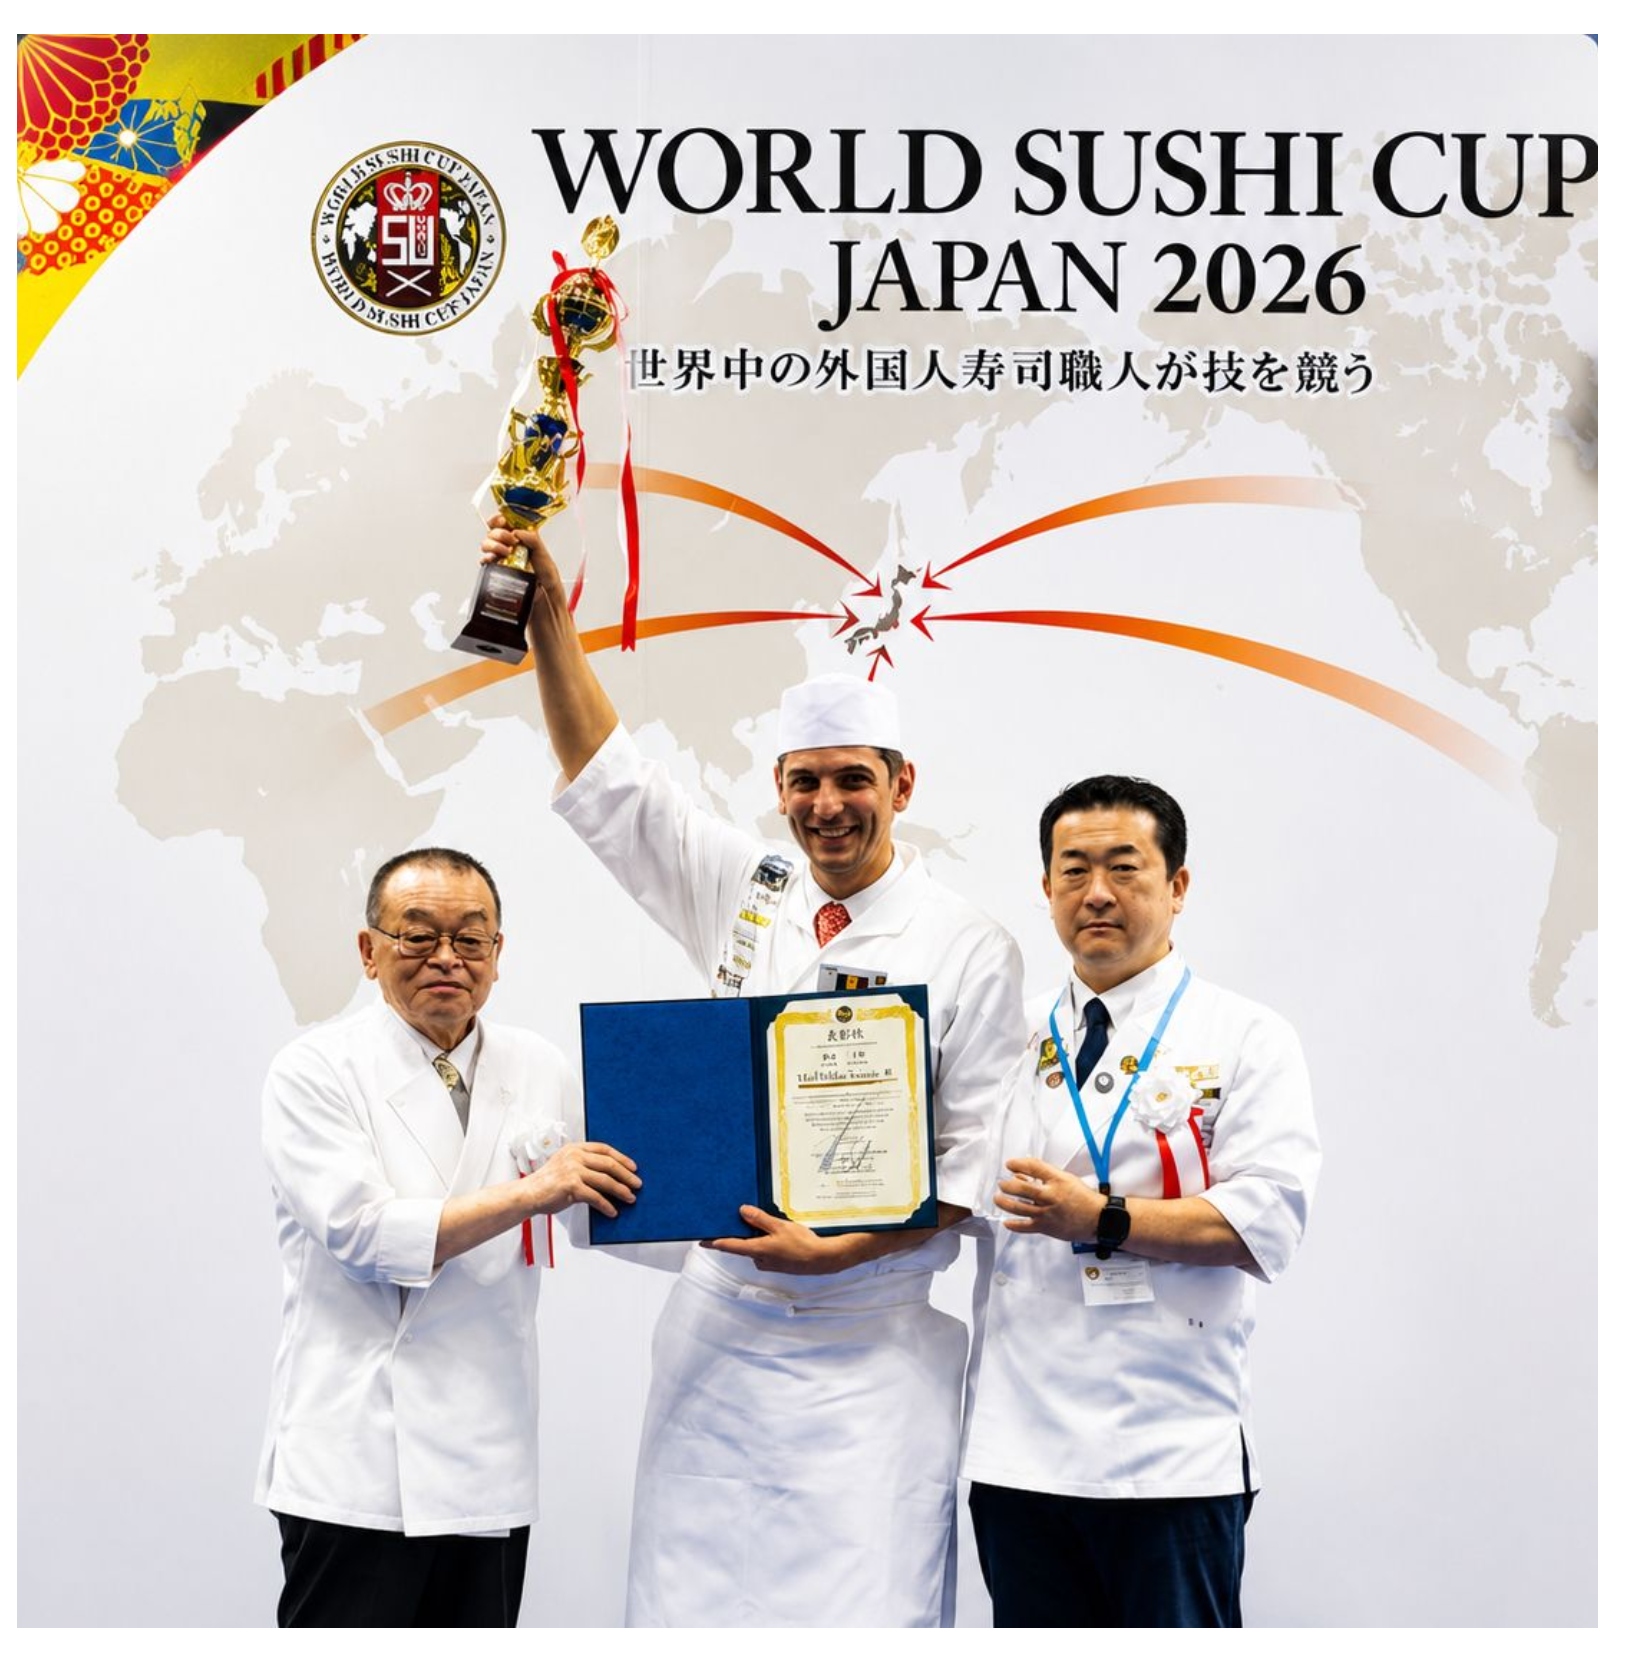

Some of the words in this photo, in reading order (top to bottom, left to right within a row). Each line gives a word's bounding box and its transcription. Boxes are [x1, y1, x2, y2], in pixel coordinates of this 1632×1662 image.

[532, 127, 982, 215] WORLD
[1014, 130, 1343, 218] SUSHI
[1371, 130, 1598, 219] CUP
[818, 239, 1125, 332] JAPAN
[1153, 243, 1367, 317] 2026
